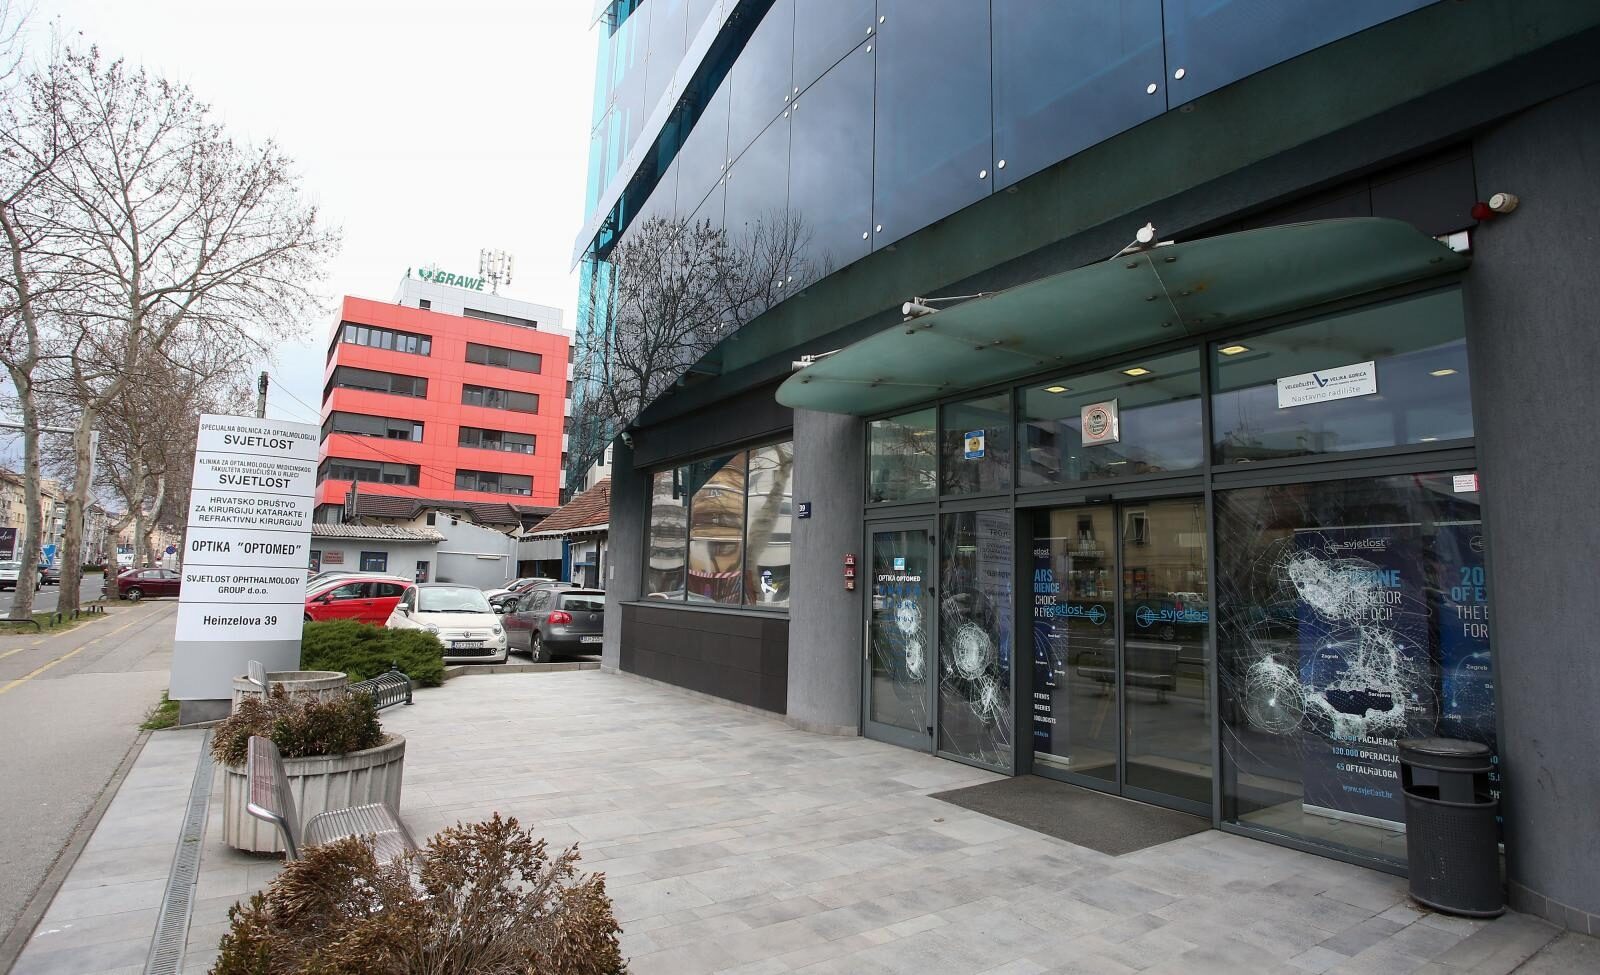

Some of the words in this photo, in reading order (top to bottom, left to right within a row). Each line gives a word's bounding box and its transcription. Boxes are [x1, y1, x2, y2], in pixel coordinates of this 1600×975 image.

[435, 271, 485, 291] GRAWE
[1348, 371, 1367, 379] GORICA
[1292, 392, 1326, 402] Nastavno
[1328, 386, 1360, 396] radilište
[201, 423, 235, 432] SPECIJALNA
[236, 425, 262, 435] BOLNICA
[272, 429, 317, 441] OFTALMOLOGIJU
[224, 434, 294, 450] SVJETLOST
[211, 465, 241, 473] FAKULTETA
[229, 460, 275, 470] OFTALMOLOGIJU
[276, 463, 312, 473] MEDICINSKOG
[218, 474, 290, 489] SVJETLOST
[209, 496, 255, 506] HRVATSKO
[257, 498, 296, 509] DRUŠTVO
[208, 506, 254, 515] KIRURGIJU
[256, 508, 303, 518] KATARAKTE
[198, 514, 257, 524] REFRAKTIVNU
[259, 517, 303, 527] KIRURGIJU
[192, 540, 231, 553] OPTIKA
[237, 542, 302, 555] "OPTOMED"
[1343, 538, 1385, 549] svjetlost
[186, 574, 231, 583] SVJETLOST
[232, 576, 300, 585] OPHTHALMOLOGY
[878, 574, 896, 582] OPTIKA
[1034, 568, 1053, 582] ARS
[1460, 566, 1484, 586] 20
[218, 586, 246, 594] GROUP
[1452, 586, 1470, 601] OF
[1035, 595, 1057, 605] CHOICE
[1455, 605, 1481, 620] THE
[203, 615, 261, 626] Heinzelova
[264, 615, 278, 626] 39
[1463, 623, 1489, 638] FOR
[1466, 663, 1488, 671] Zagreb
[1332, 746, 1358, 757] 130.000
[1359, 750, 1400, 764] OPERACIJA
[1336, 762, 1345, 771] 45
[1345, 763, 1398, 779] OFTALMOLOGA
